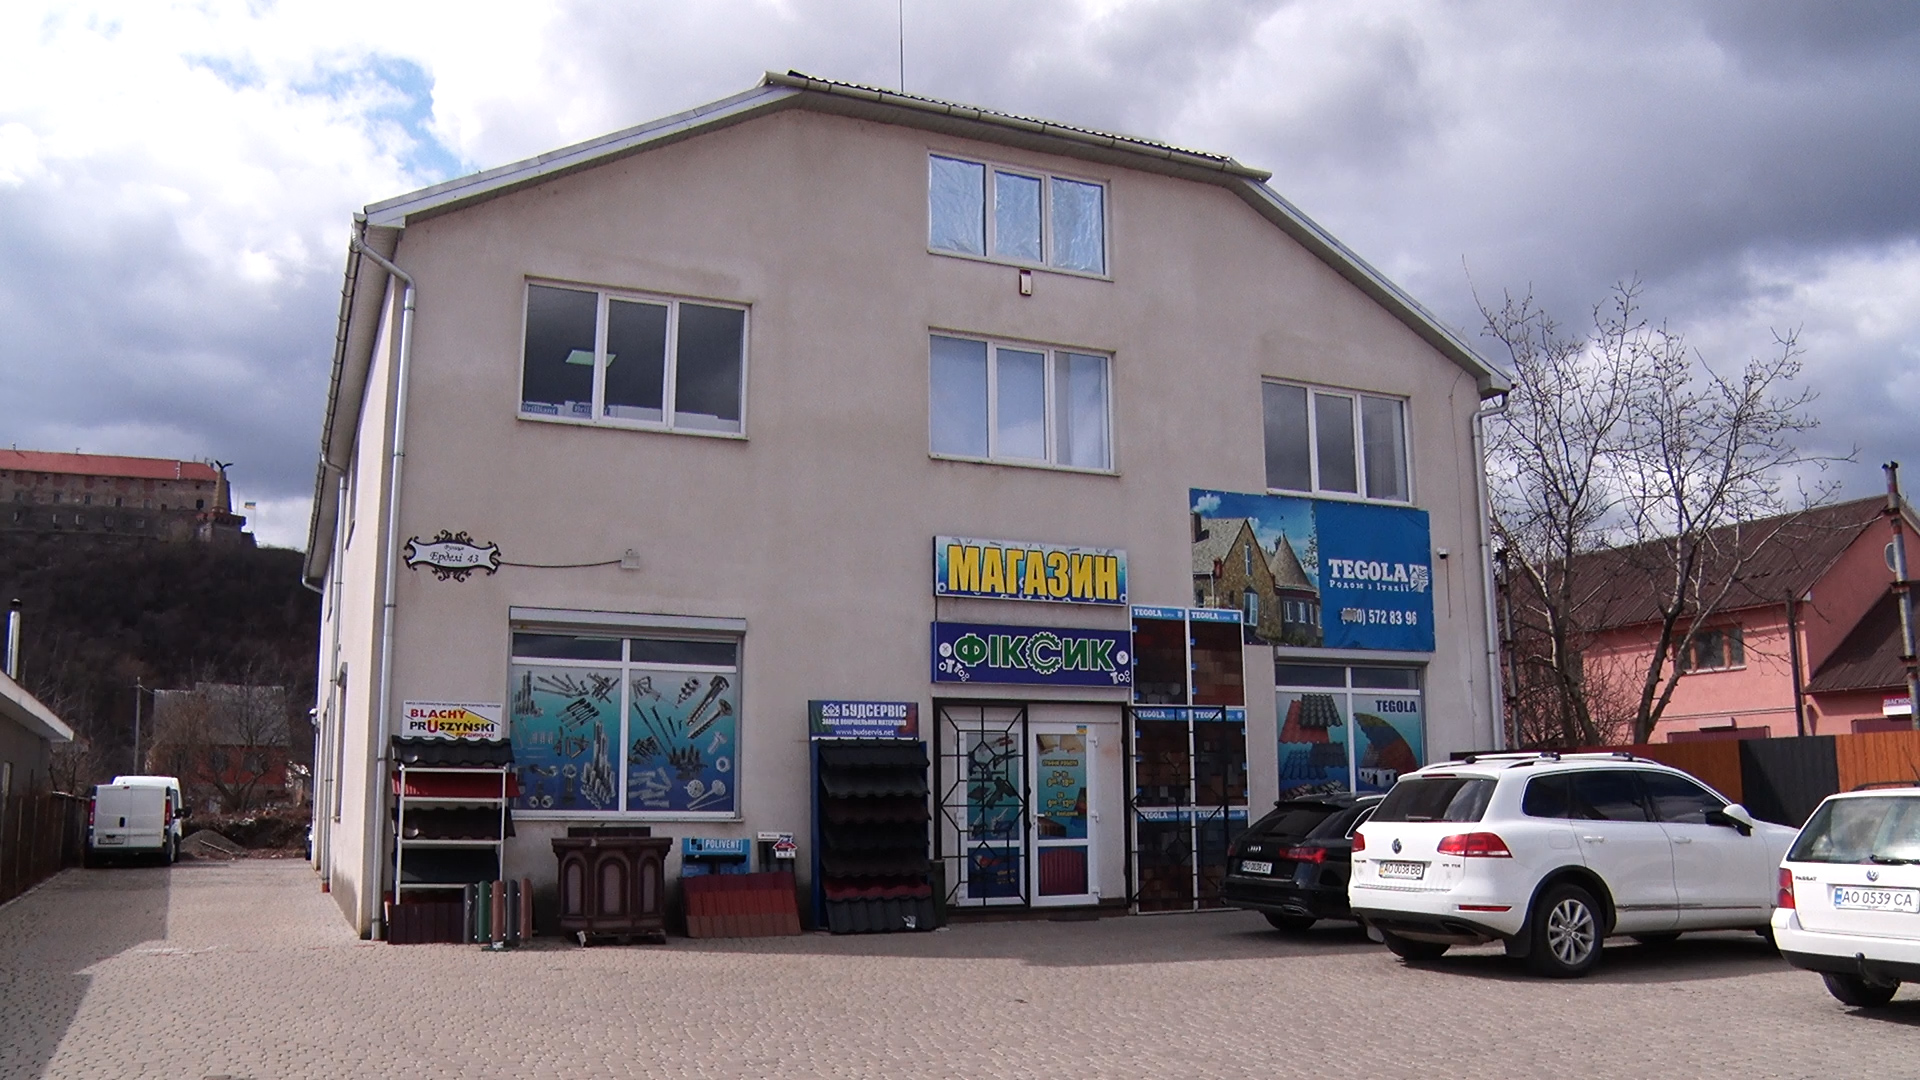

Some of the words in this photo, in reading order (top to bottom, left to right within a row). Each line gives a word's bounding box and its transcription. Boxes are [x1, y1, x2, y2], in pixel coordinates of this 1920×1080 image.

[467, 554, 479, 563] 43
[947, 544, 1117, 600] МАГАЗИН
[1328, 559, 1408, 582] TEGOLA
[1329, 579, 1364, 589] Родом
[1376, 582, 1409, 592] Італії
[1133, 608, 1163, 617] TEGOLA
[1191, 611, 1219, 620] TEGOLA
[1368, 609, 1388, 624] 572
[1389, 610, 1403, 625] 83
[1405, 611, 1417, 625] 96
[953, 632, 1116, 675] ФІКСИК
[842, 703, 907, 718] БУДСЕРВІС
[1375, 700, 1417, 713] TEGOLA
[410, 708, 466, 719] BLACHY
[1138, 709, 1166, 718] TEGOLA
[410, 720, 495, 733] PRUSZYŃSKI
[836, 728, 894, 736] www.budservis.net
[705, 839, 740, 849] POLIVENT
[1384, 864, 1393, 873] AO
[1394, 864, 1409, 874] 0038
[1410, 865, 1421, 875] BB
[1842, 891, 1860, 903] AO
[1862, 892, 1891, 905] 0539
[1894, 894, 1912, 906] CA
